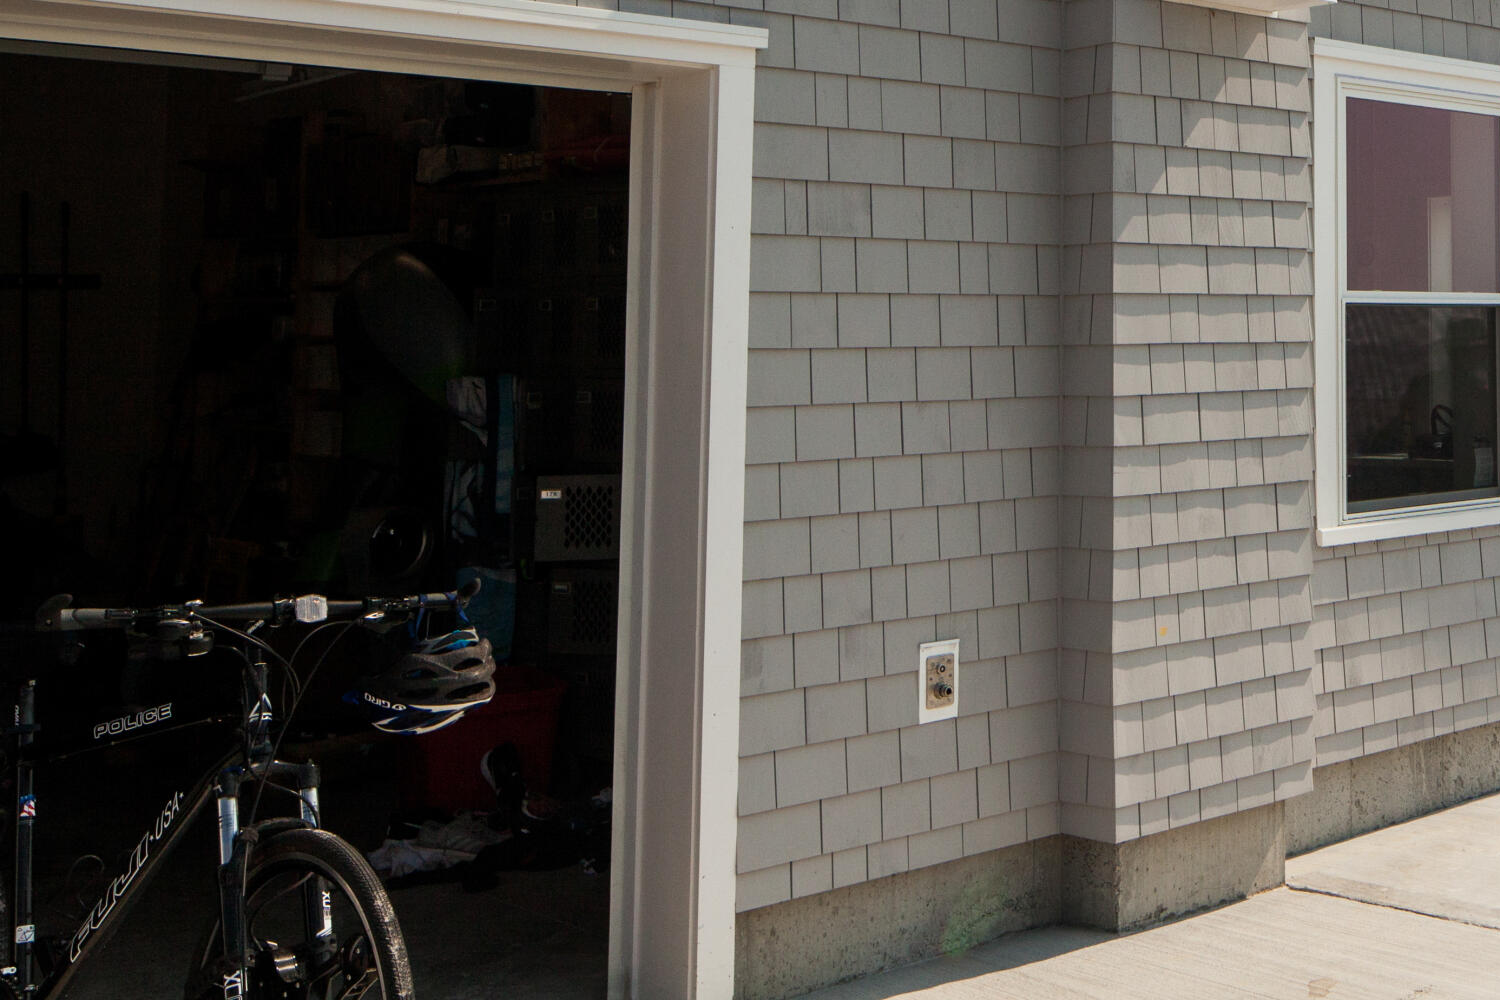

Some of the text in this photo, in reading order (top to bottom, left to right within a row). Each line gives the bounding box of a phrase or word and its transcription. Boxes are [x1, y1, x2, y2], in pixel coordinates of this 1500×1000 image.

[364, 692, 391, 708] GIRO
[93, 702, 173, 739] POLICE
[70, 791, 180, 963] FUJI USA
